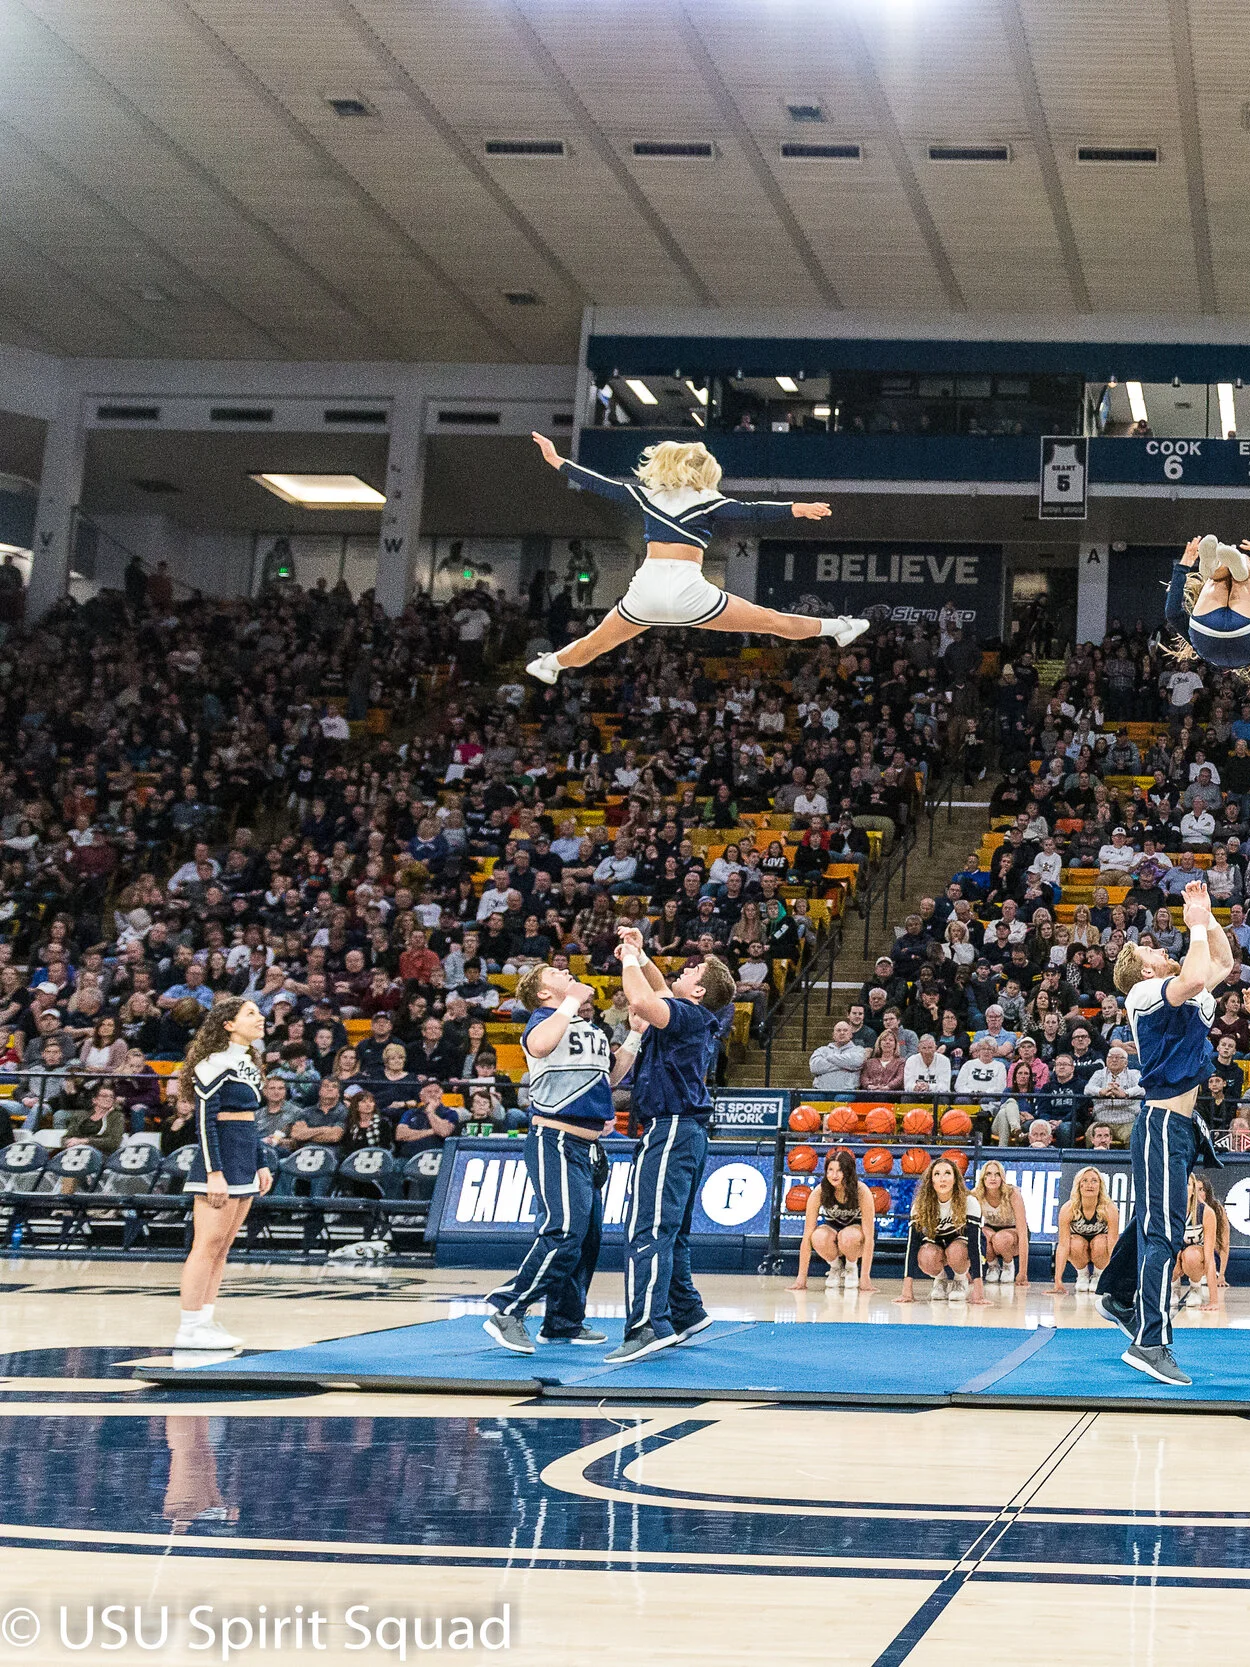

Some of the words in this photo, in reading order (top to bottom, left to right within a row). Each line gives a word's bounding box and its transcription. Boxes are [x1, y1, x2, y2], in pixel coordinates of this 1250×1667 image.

[1146, 441, 1201, 455] COOK
[1163, 455, 1184, 480] 6
[1057, 475, 1071, 492] 5
[384, 538, 403, 553] W
[735, 542, 749, 557] X
[1087, 548, 1101, 563] A
[784, 553, 795, 581] I
[816, 553, 979, 584] BELIEVE
[762, 856, 787, 868] LOVE
[728, 1102, 777, 1114] SPORTS
[722, 1178, 747, 1209] F
